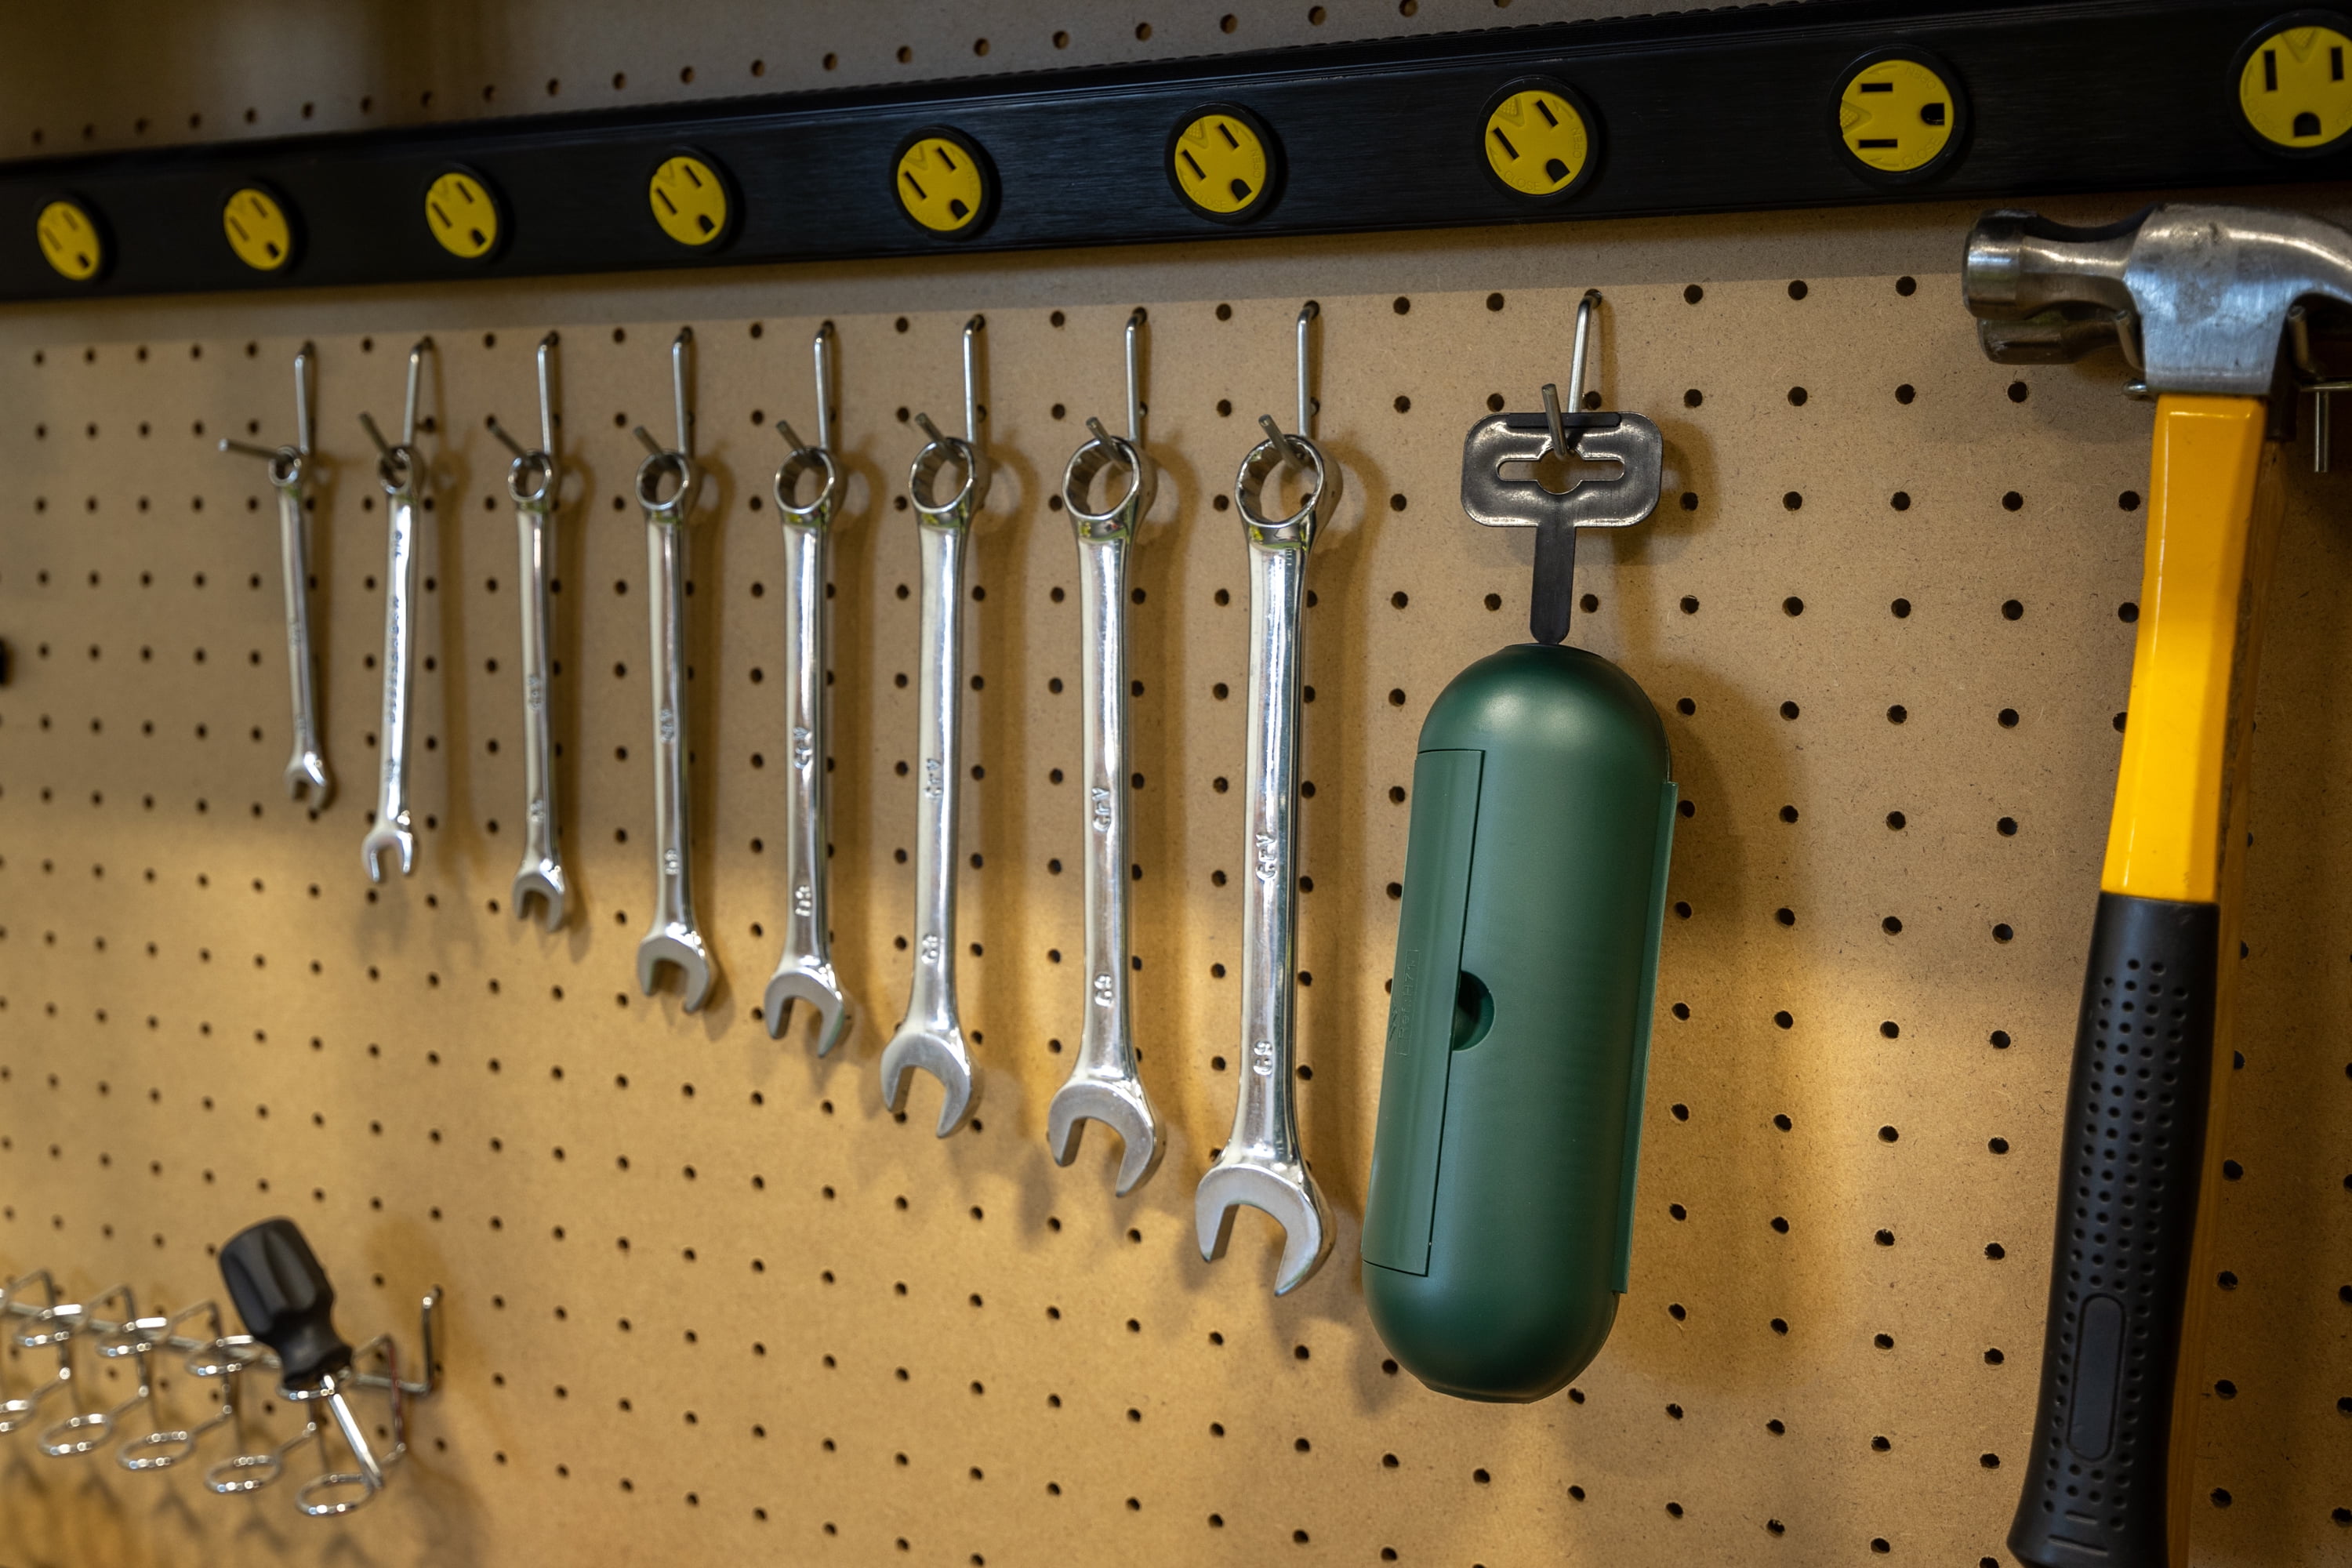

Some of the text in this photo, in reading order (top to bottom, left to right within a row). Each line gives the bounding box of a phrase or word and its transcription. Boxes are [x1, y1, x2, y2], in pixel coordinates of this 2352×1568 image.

[1571, 128, 1582, 158] OPEN
[1902, 136, 1942, 167] CLOSE
[1504, 171, 1541, 191] CLOSE
